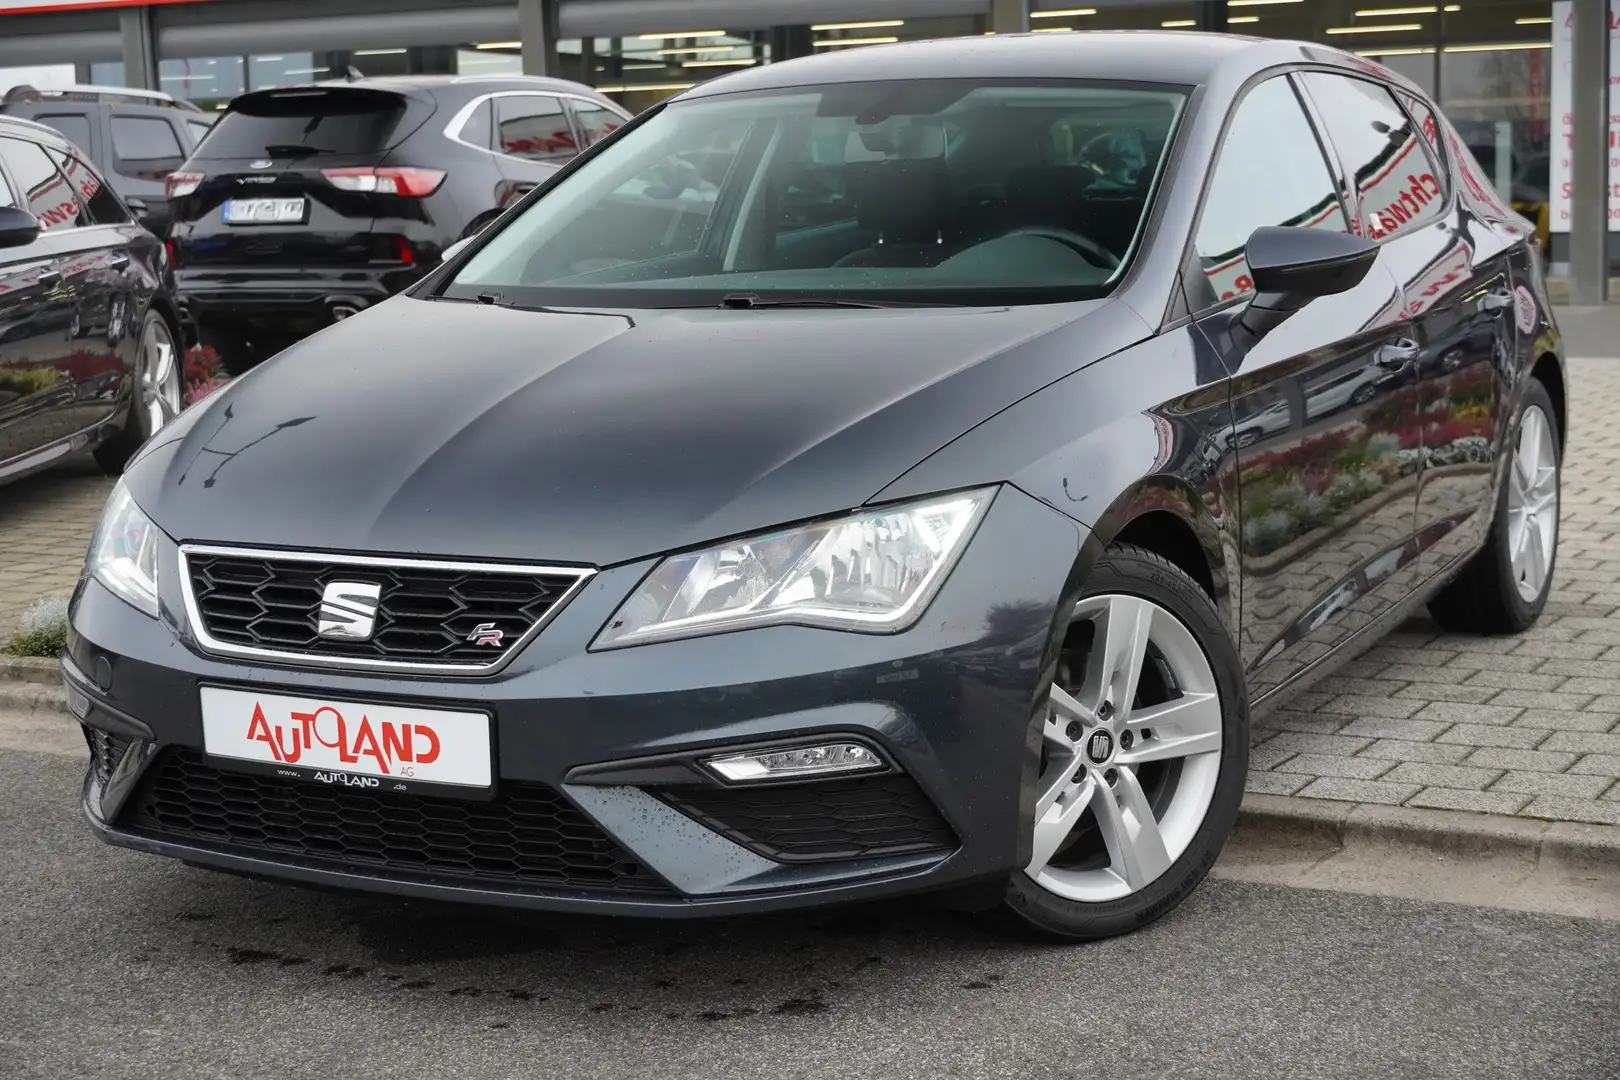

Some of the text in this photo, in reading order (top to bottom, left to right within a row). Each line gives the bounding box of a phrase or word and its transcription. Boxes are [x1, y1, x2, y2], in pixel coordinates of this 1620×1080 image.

[466, 621, 504, 647] FR
[276, 769, 301, 778] www.
[400, 766, 415, 777] AG
